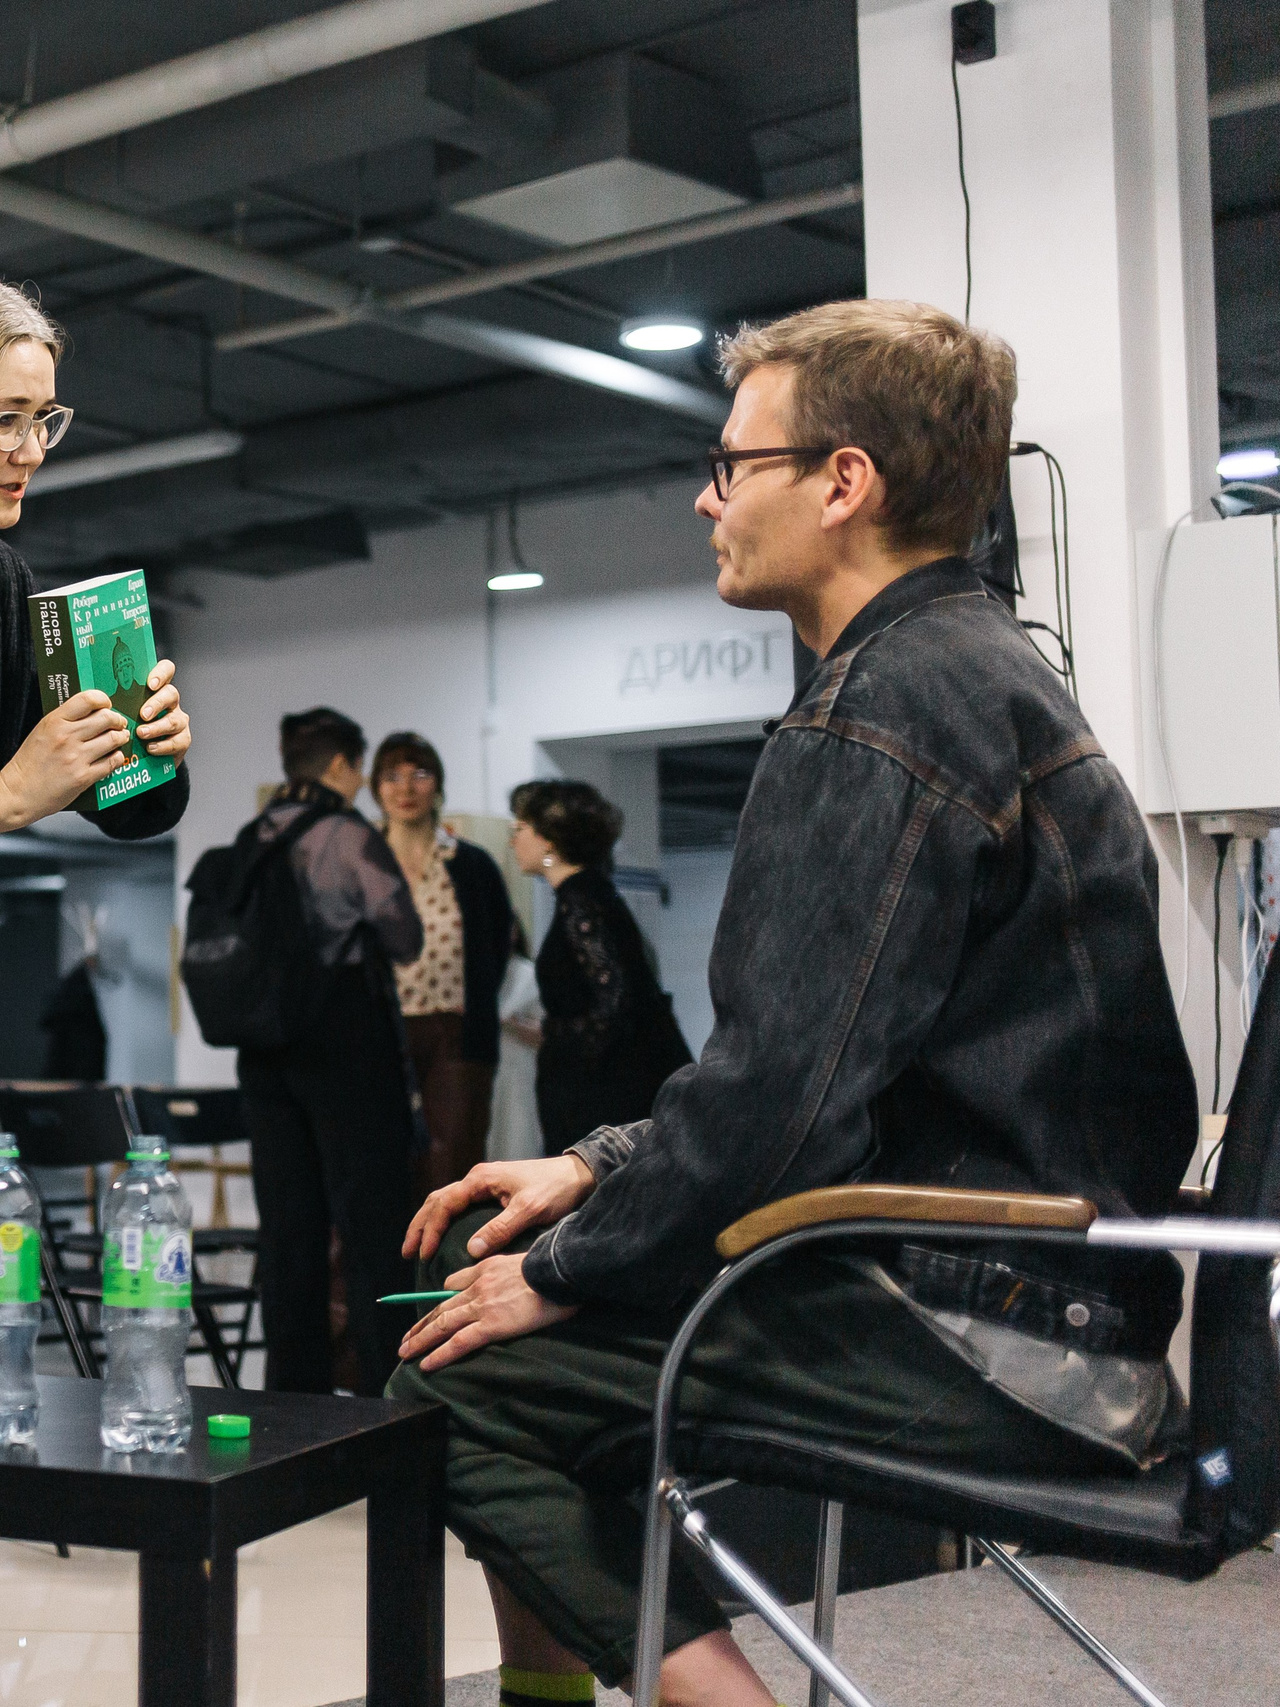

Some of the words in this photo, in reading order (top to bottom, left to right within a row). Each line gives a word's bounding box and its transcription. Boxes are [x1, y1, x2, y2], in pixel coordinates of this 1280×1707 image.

[72, 595, 99, 610] Роберт
[39, 601, 54, 657] пацана
[48, 600, 62, 647] слово
[618, 630, 785, 694] ДРИФТ
[99, 768, 152, 801] пацана
[162, 762, 174, 775] 18+
